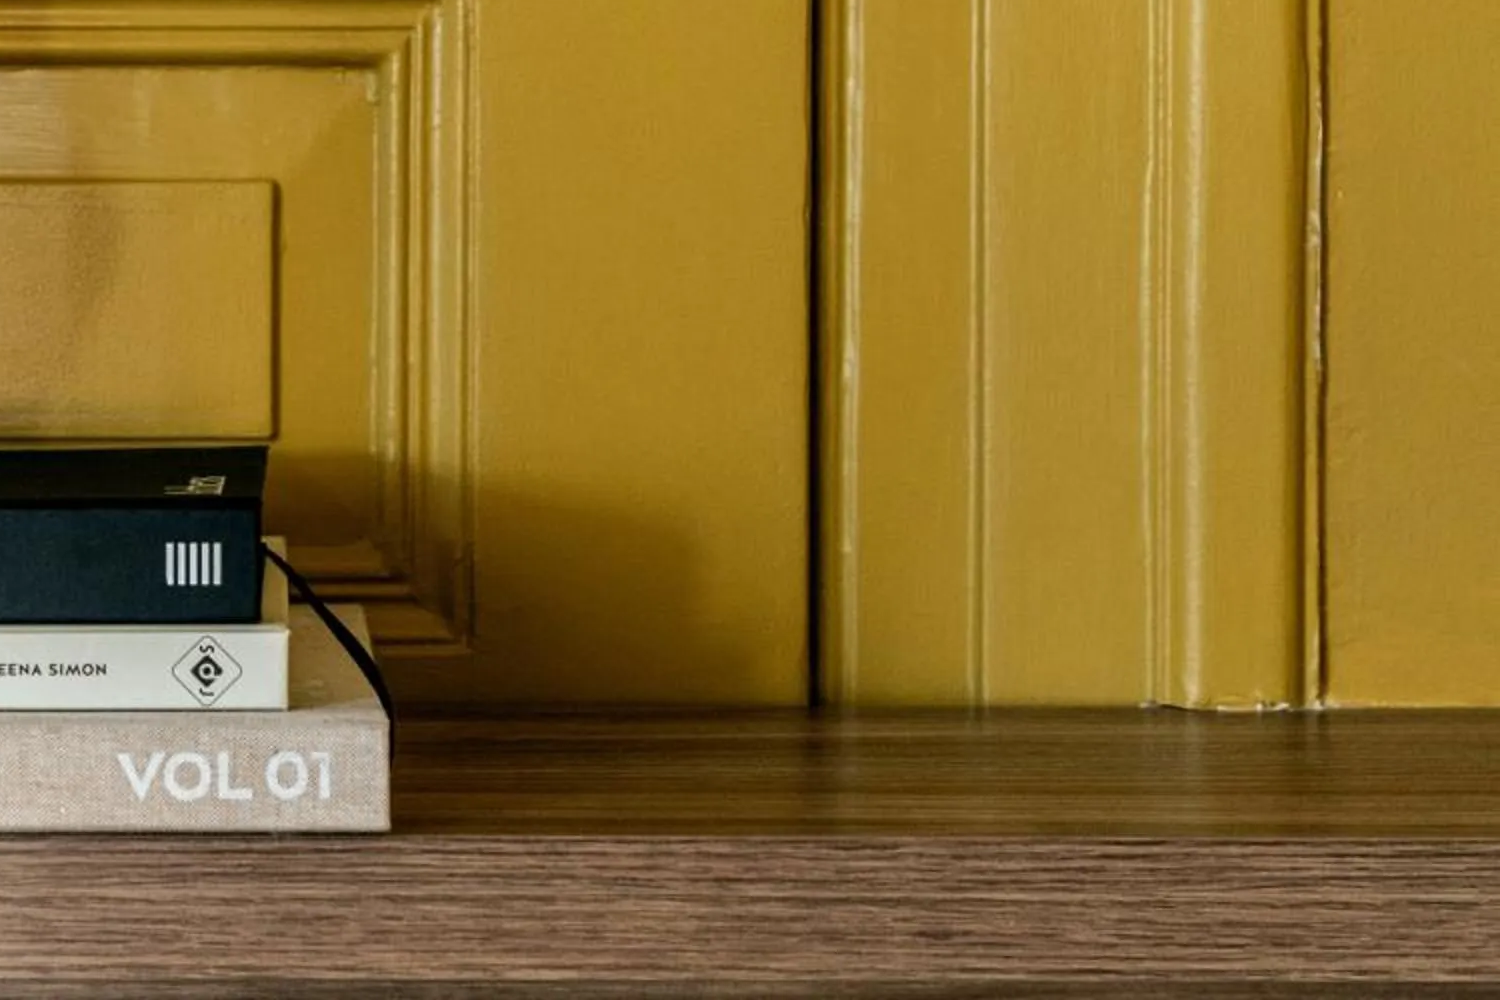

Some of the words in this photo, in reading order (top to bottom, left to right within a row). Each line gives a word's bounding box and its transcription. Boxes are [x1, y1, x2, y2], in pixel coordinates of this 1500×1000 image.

[48, 662, 107, 677] SIMON
[117, 751, 253, 802] VOL
[265, 751, 331, 801] 01
